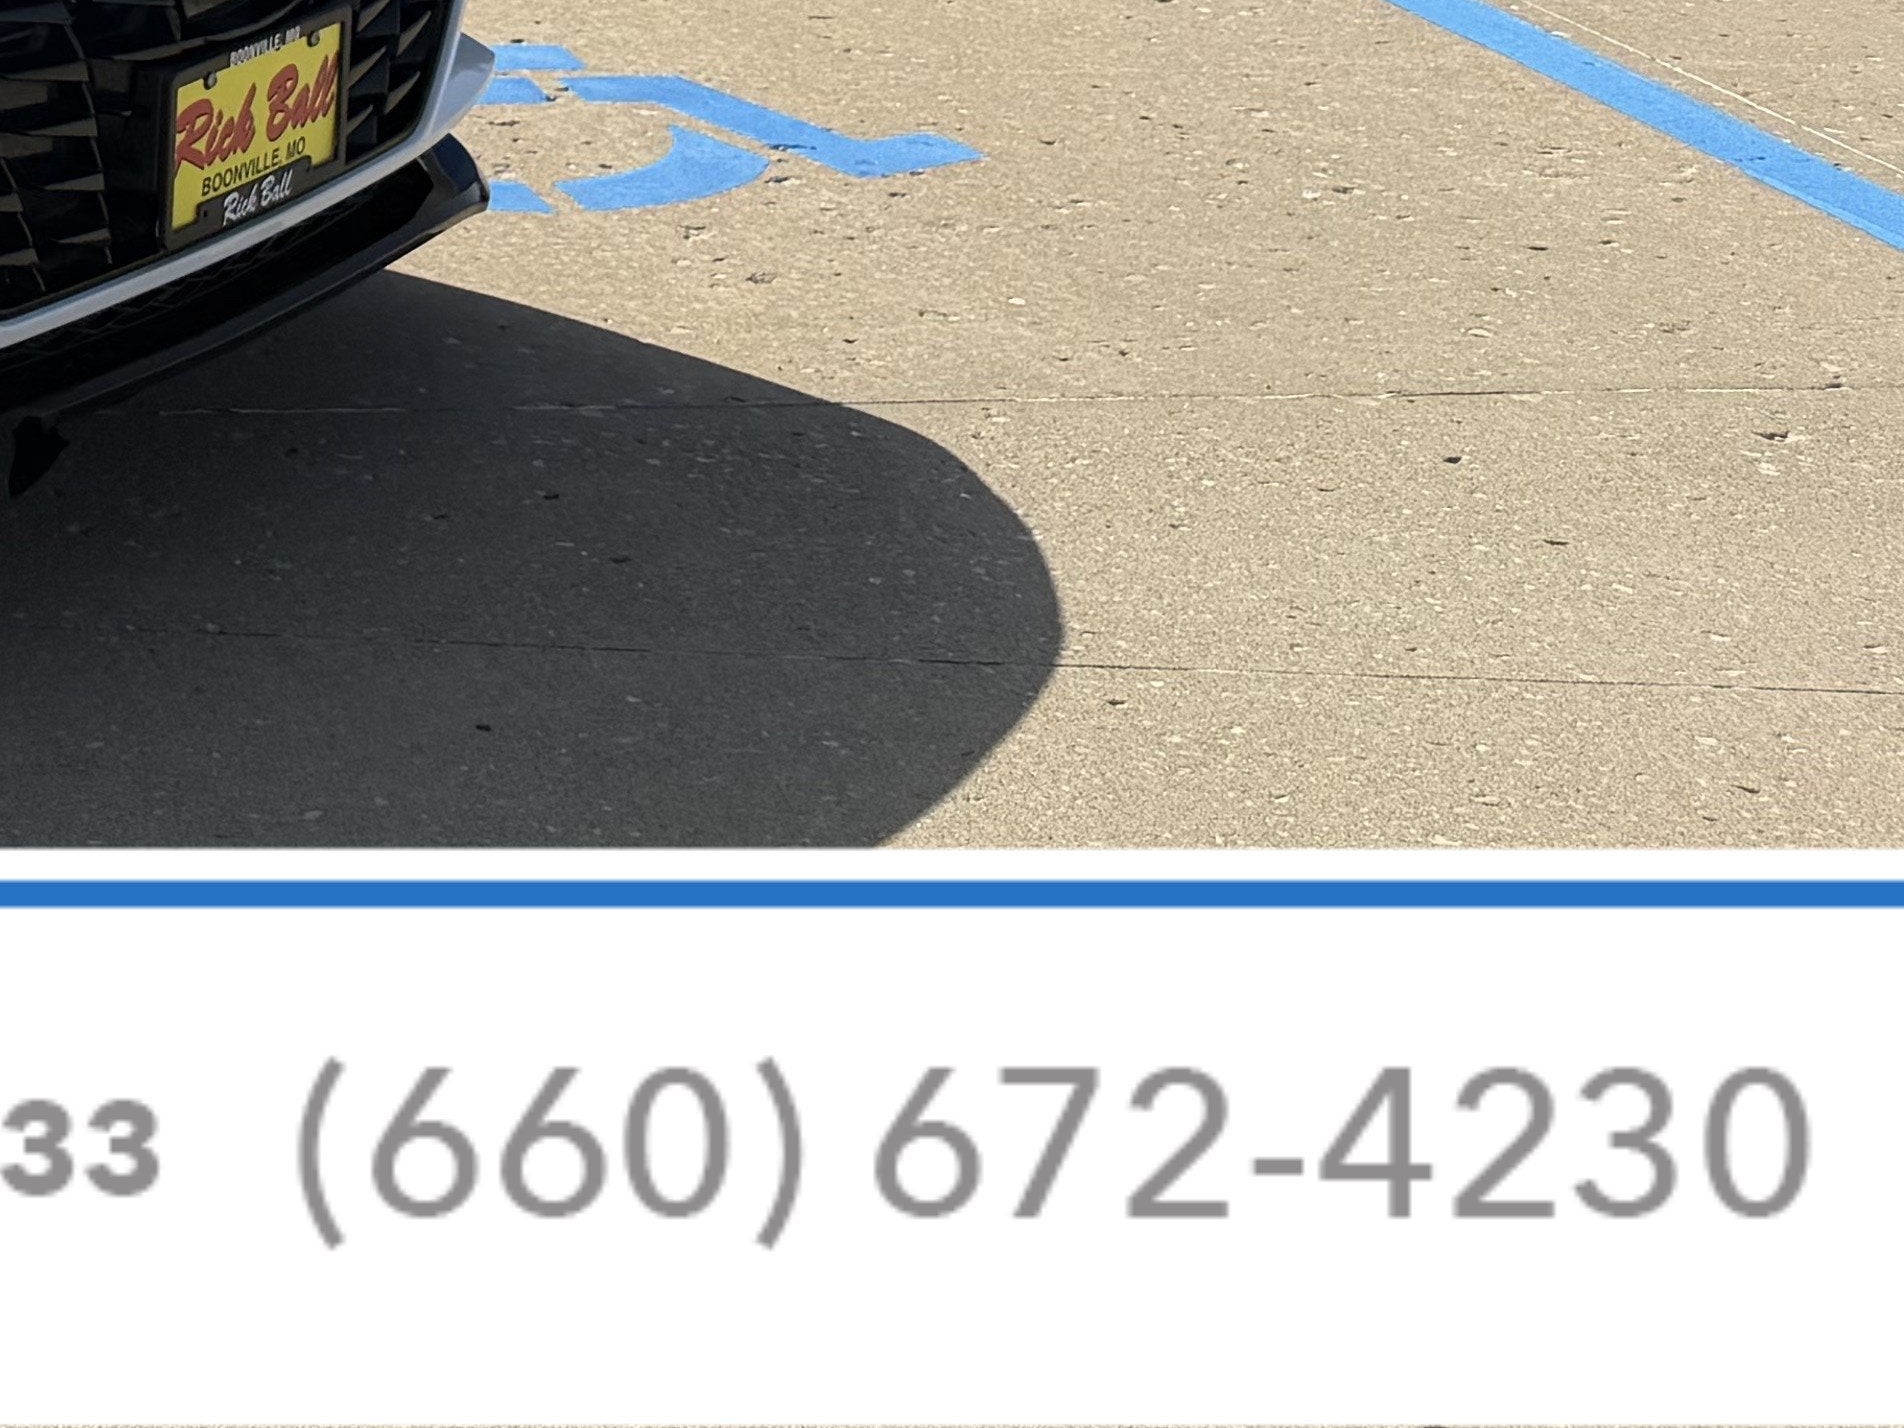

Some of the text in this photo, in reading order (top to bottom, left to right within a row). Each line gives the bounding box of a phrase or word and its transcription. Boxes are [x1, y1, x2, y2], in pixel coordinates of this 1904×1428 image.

[175, 51, 340, 178] Rick Ball
[286, 136, 306, 162] MO
[223, 168, 293, 226] Rick Ball
